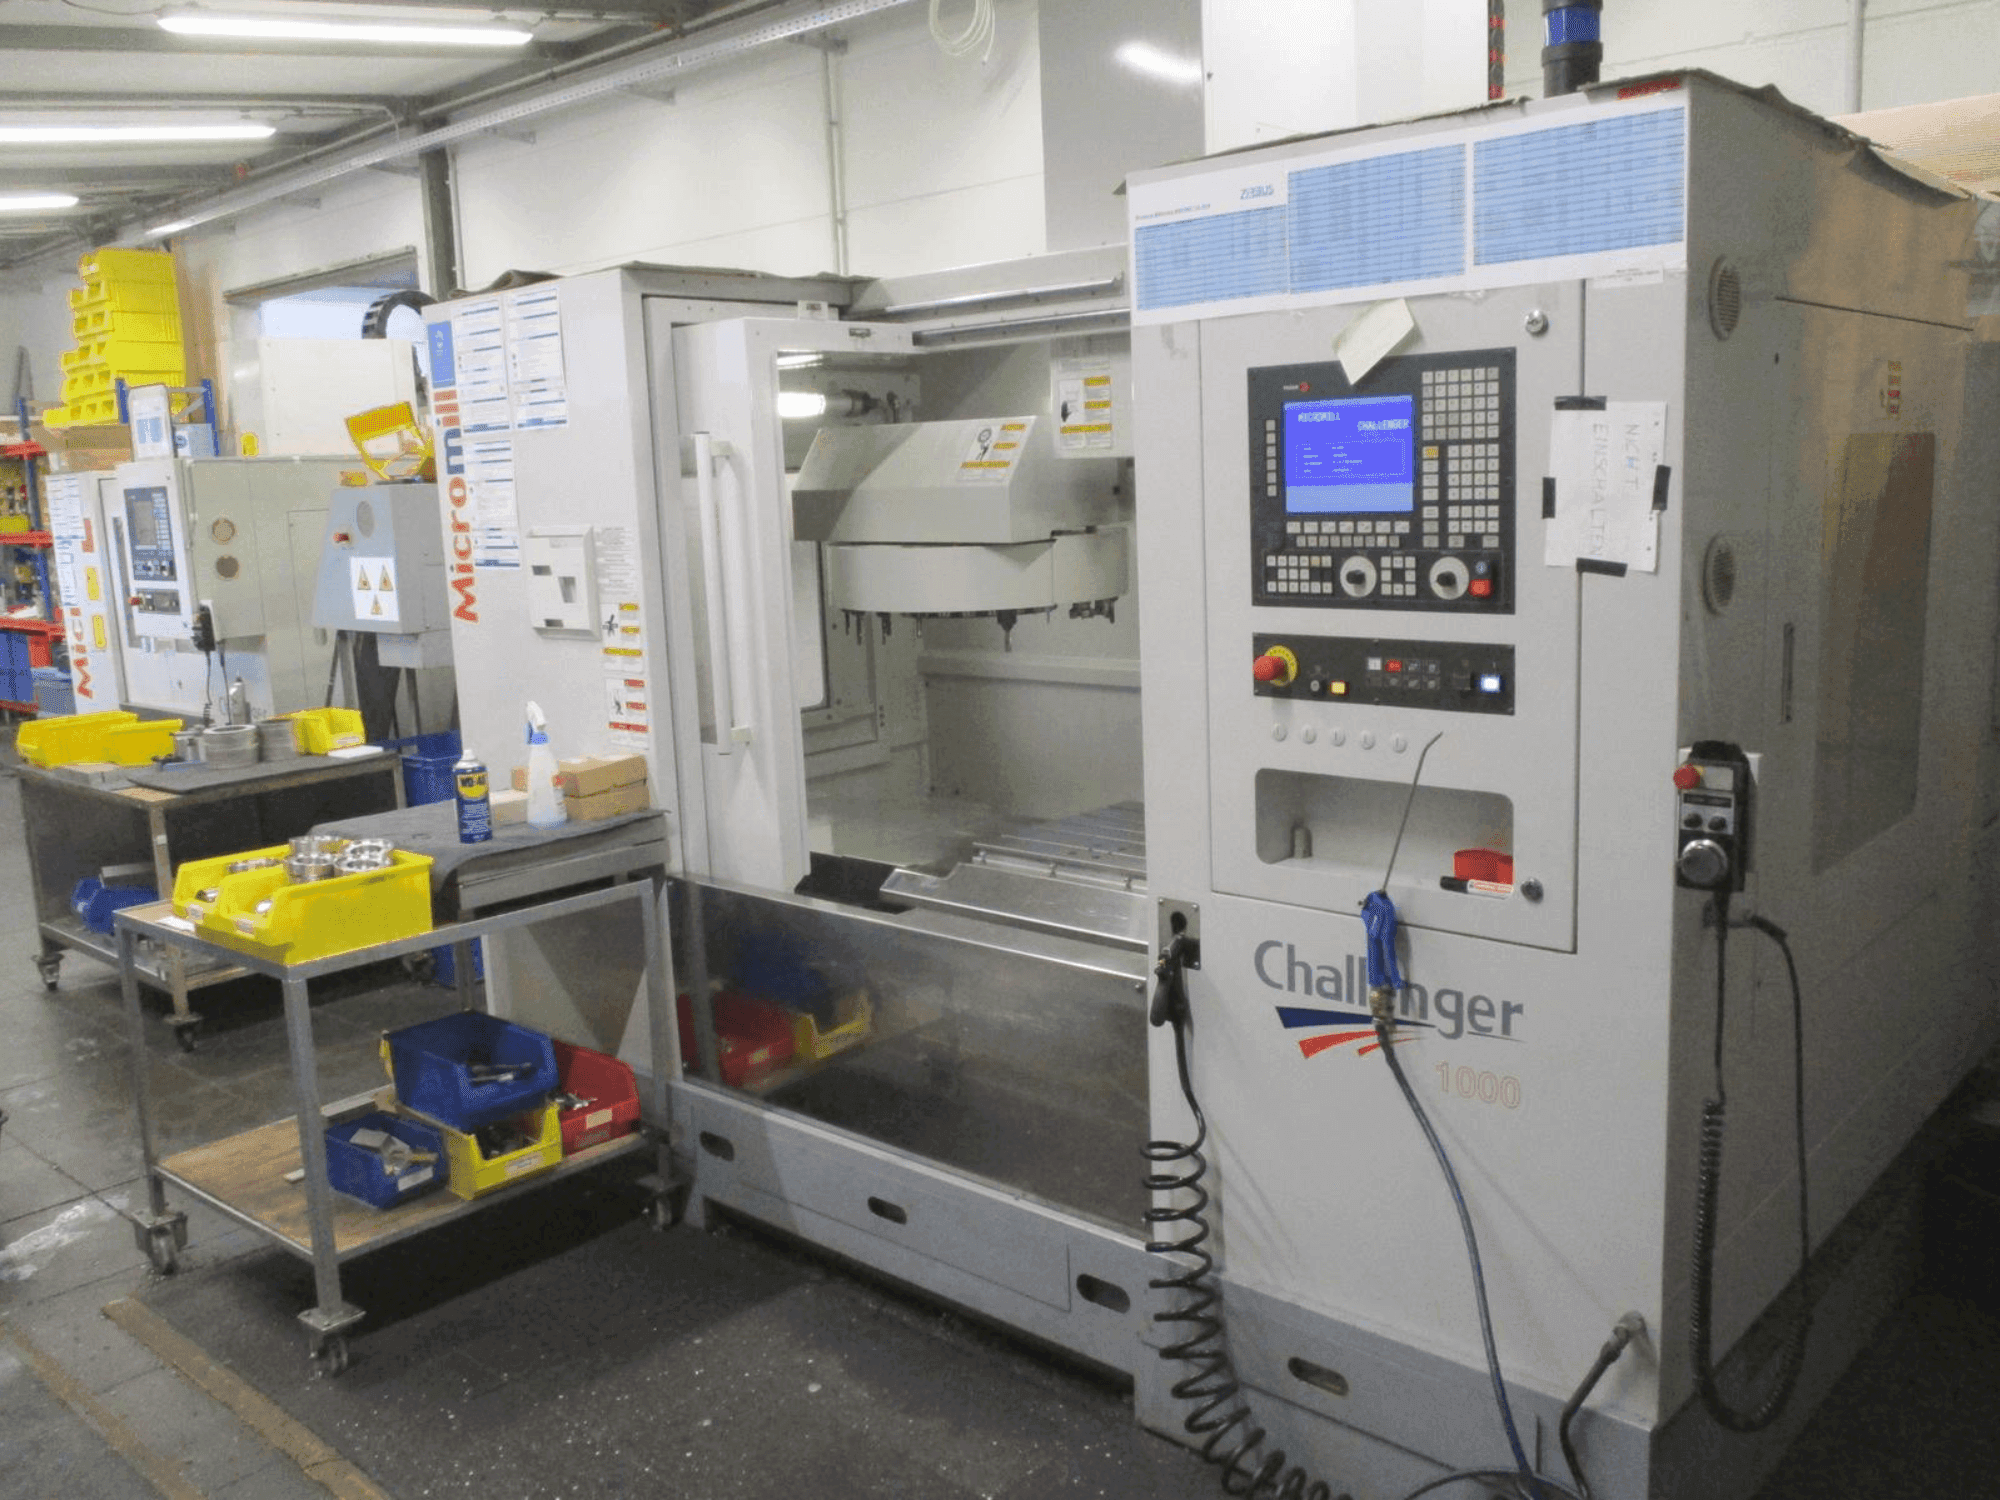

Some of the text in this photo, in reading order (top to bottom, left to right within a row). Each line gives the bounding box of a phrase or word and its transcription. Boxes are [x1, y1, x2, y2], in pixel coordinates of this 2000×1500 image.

[432, 389, 479, 623] Micromill
[1254, 940, 1524, 1040] Challnger
[1435, 1060, 1521, 1109] 1000
